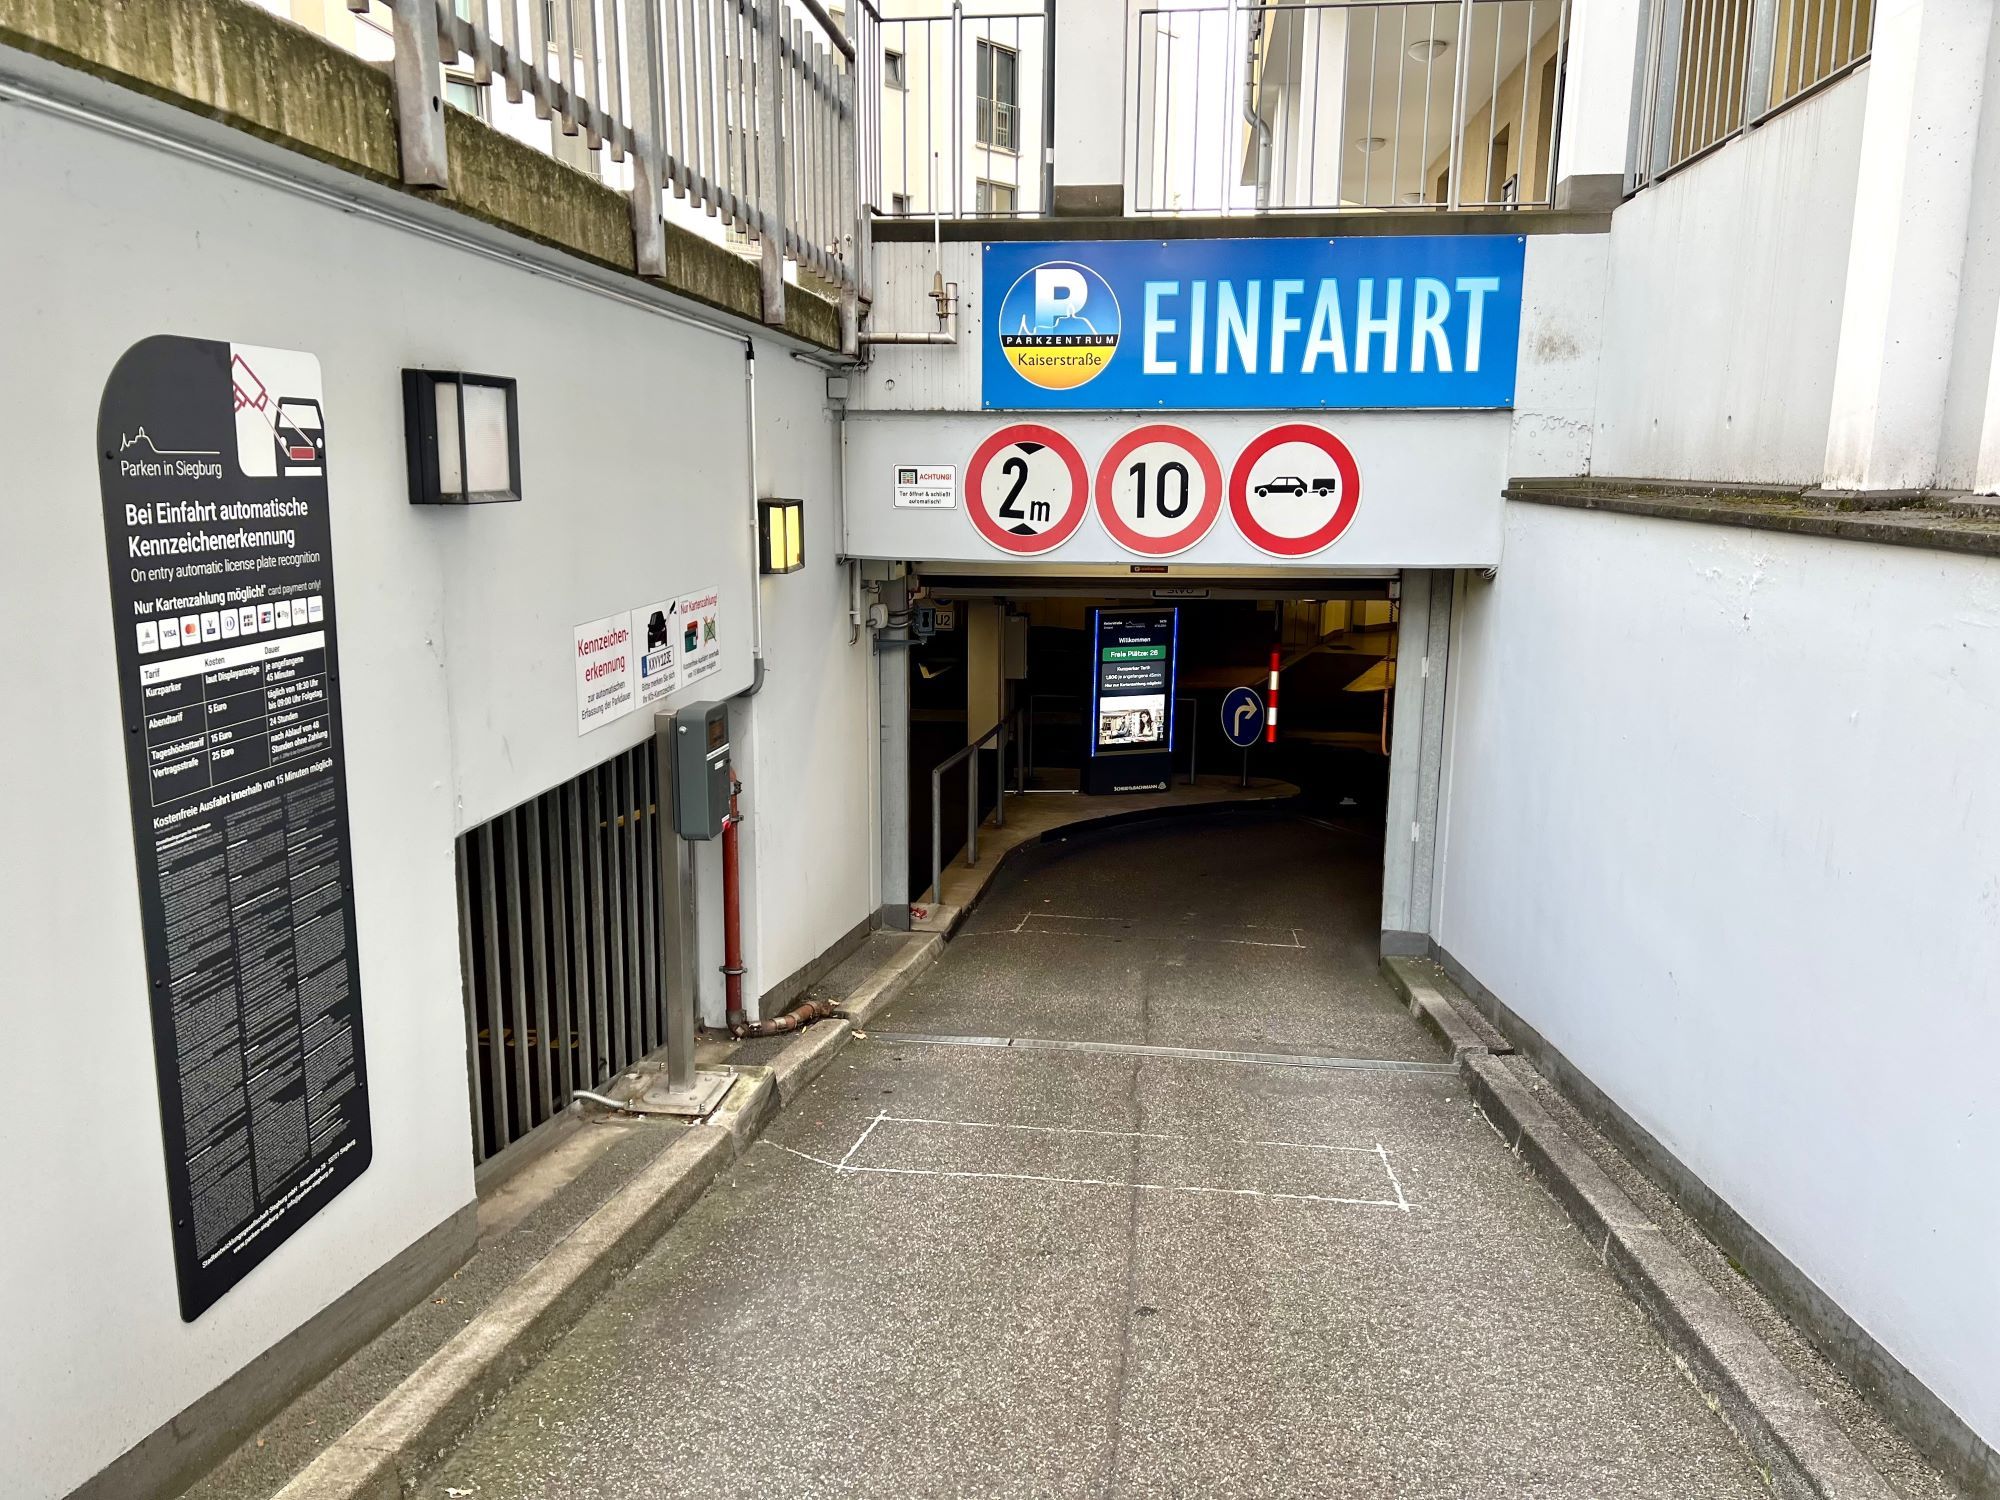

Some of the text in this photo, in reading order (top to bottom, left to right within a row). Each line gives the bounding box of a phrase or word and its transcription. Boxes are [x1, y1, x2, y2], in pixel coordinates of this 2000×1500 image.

[1035, 268, 1088, 335] P
[1142, 276, 1500, 376] EINFAHRT
[1006, 336, 1114, 345] PARKZENTRUM
[1018, 352, 1102, 366] Kaiserstraße
[121, 460, 223, 479] Parken in Siegburg
[1129, 461, 1189, 518] 10
[125, 497, 309, 526] Bei Einfahrt automatische
[128, 528, 295, 558] Kennzeichenerkennung
[130, 551, 320, 583] On entry automatic license plate recognition
[134, 600, 153, 615] Nur
[155, 592, 226, 613] Kartenzahlung
[268, 585, 281, 595] card
[282, 582, 307, 595] payment
[308, 580, 321, 591] only!
[689, 593, 717, 612] Kartenzahlung!
[935, 614, 951, 626] U2
[163, 629, 177, 638] VISA
[577, 628, 629, 658] Kennzeichen-
[265, 646, 280, 655] Dauer
[204, 657, 225, 667] Kosten
[265, 656, 304, 672] je angefangene
[585, 656, 625, 682] erkennung
[144, 668, 160, 679] Tarif
[205, 665, 260, 684] laut Displayanzeige
[266, 669, 295, 681] 45 Minuten
[146, 682, 182, 698] Kurzparker
[267, 687, 285, 699] täglich
[286, 685, 295, 694] von
[309, 679, 318, 688] Uhr
[587, 681, 625, 703] zur automatischen
[208, 702, 227, 714] 5 Euro
[268, 701, 276, 710] bis
[292, 695, 301, 704] Uhr
[302, 690, 323, 701] Folgetag
[581, 702, 604, 720] Erfassung
[612, 692, 631, 706] Parkdauer
[148, 712, 183, 729] Abendtarif
[269, 712, 298, 726] 24 Stunden
[211, 731, 233, 743] 15 Euro
[271, 731, 284, 743] nach
[284, 725, 302, 738] Ablauf
[302, 723, 312, 732] von
[271, 741, 293, 754] Stunden
[294, 735, 307, 746] ohne
[307, 730, 328, 742] Zahlung
[151, 737, 205, 760] Tageshöchsttarif
[211, 747, 235, 761] 25 Euro
[152, 757, 199, 778] Vertragsstrafe
[153, 805, 199, 829] Kostenfreie
[199, 793, 231, 813] Ausfahrt
[231, 782, 263, 801] innerhalb
[263, 779, 276, 790] von
[276, 774, 284, 785] 15
[284, 767, 309, 783] Minuten
[309, 757, 333, 772] möglich
